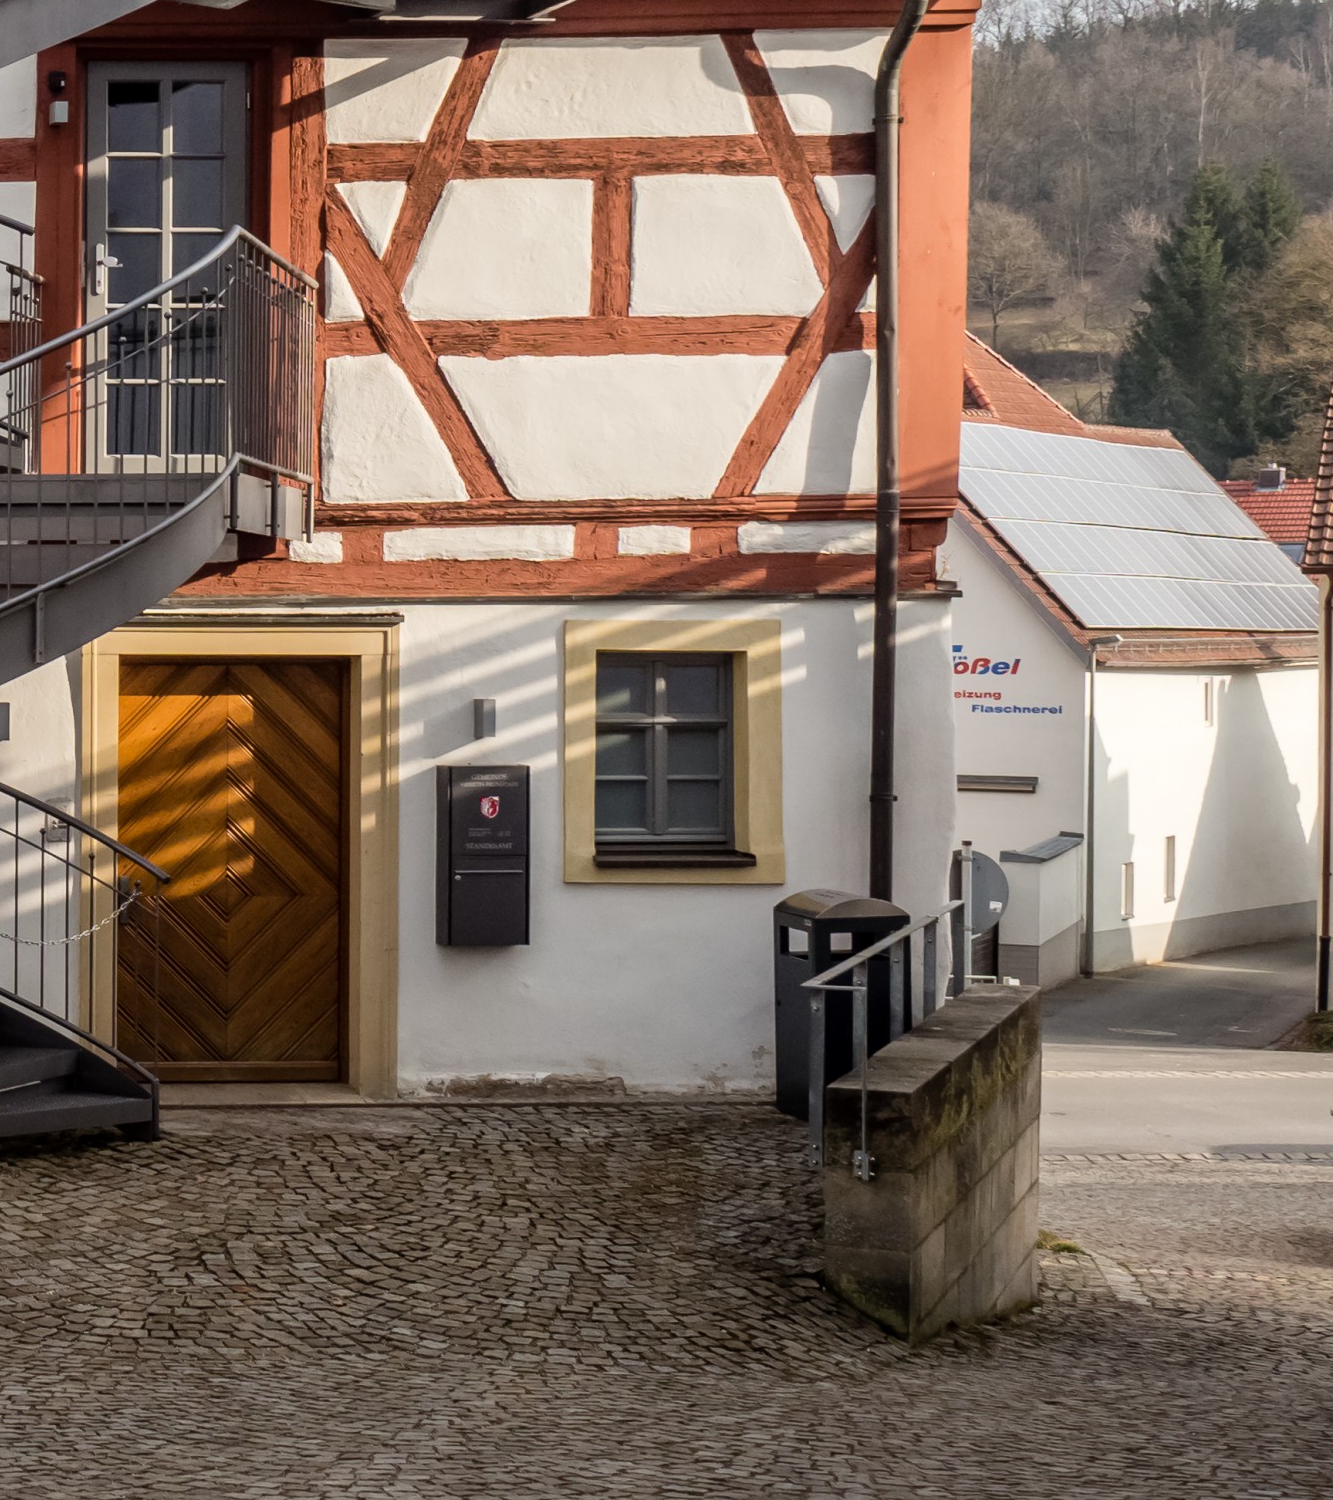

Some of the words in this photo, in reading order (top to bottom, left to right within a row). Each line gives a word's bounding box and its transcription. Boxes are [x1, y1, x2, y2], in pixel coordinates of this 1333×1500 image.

[954, 655, 1021, 675] ößel
[954, 690, 1002, 701] eizung
[972, 704, 1063, 715] Flaschnerei
